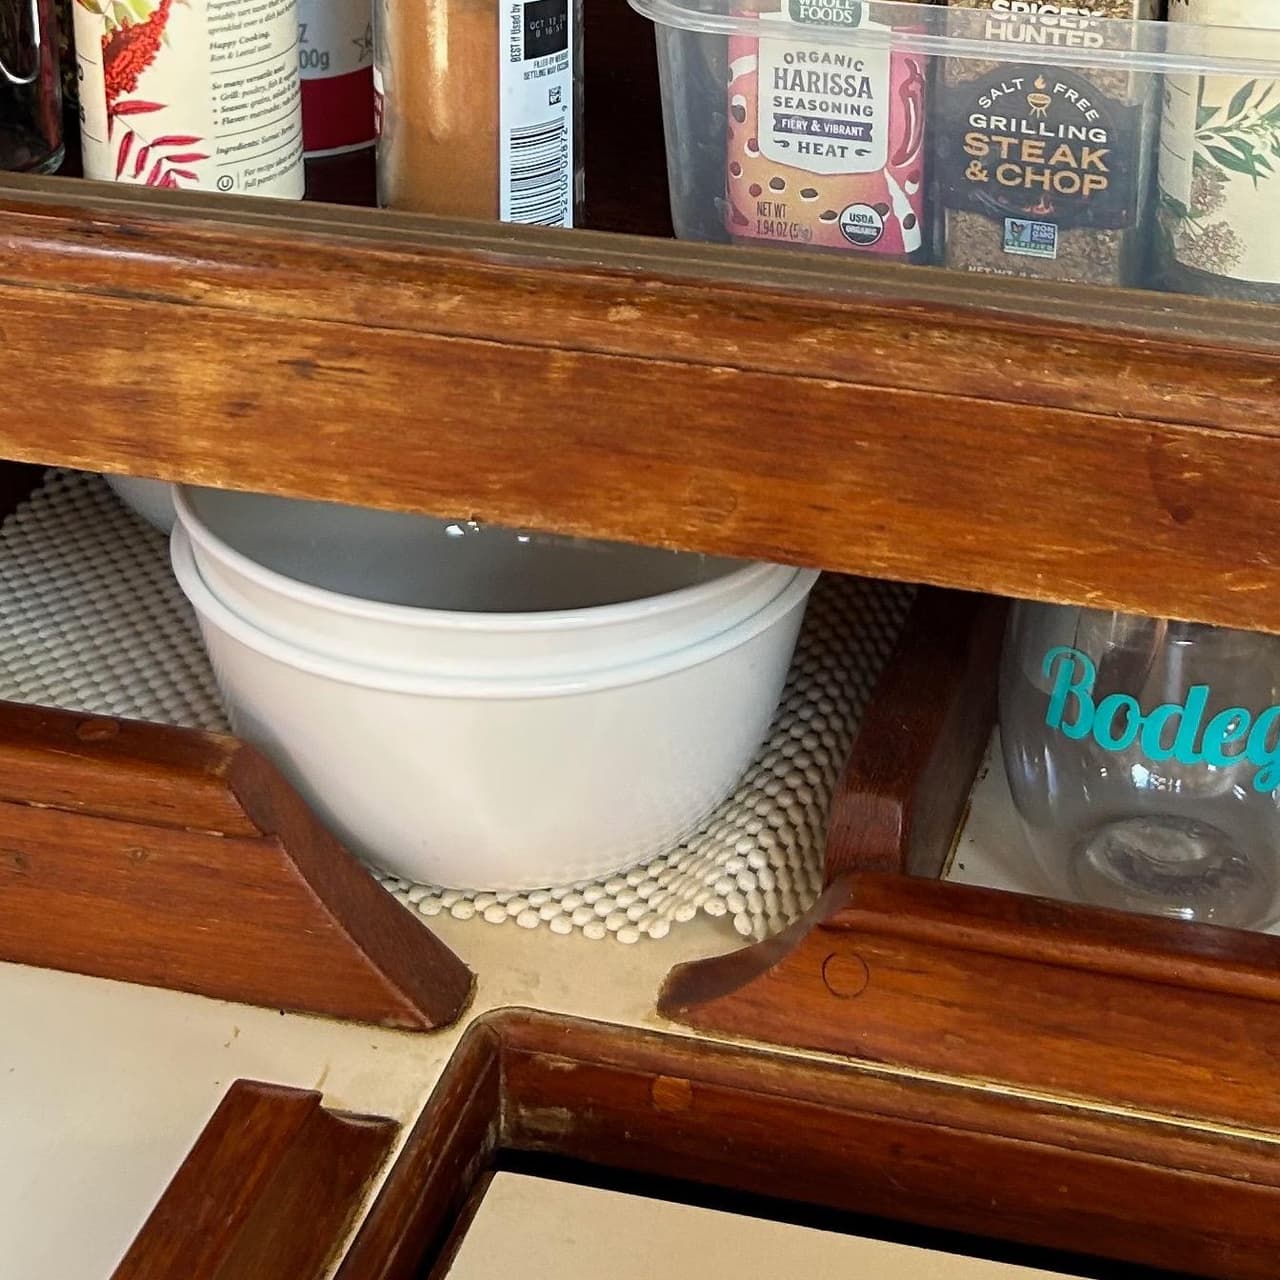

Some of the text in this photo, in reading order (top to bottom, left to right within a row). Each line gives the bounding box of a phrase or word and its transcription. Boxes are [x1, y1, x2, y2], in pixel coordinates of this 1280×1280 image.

[510, 14, 522, 35] Used
[800, 6, 853, 24] FOODS
[985, 20, 1104, 49] HUNTER
[209, 40, 237, 51] Happy
[510, 43, 522, 63] BEST
[784, 52, 864, 72] ORGANIC
[773, 67, 874, 100] HARISSA
[773, 96, 874, 117] SEASONING
[978, 78, 1100, 122] SALT FREE
[781, 118, 864, 137] FIERY & VIBRANT
[969, 113, 1108, 144] GRILLING
[797, 141, 849, 159] HEAT
[963, 132, 1112, 173] STEAK
[965, 160, 1108, 196] & CHOP
[757, 201, 787, 219] NET WT
[849, 212, 874, 224] USDA
[756, 220, 776, 236] 1.94
[777, 221, 788, 238] OZ
[1032, 231, 1054, 240] GMO
[1033, 224, 1055, 234] NON
